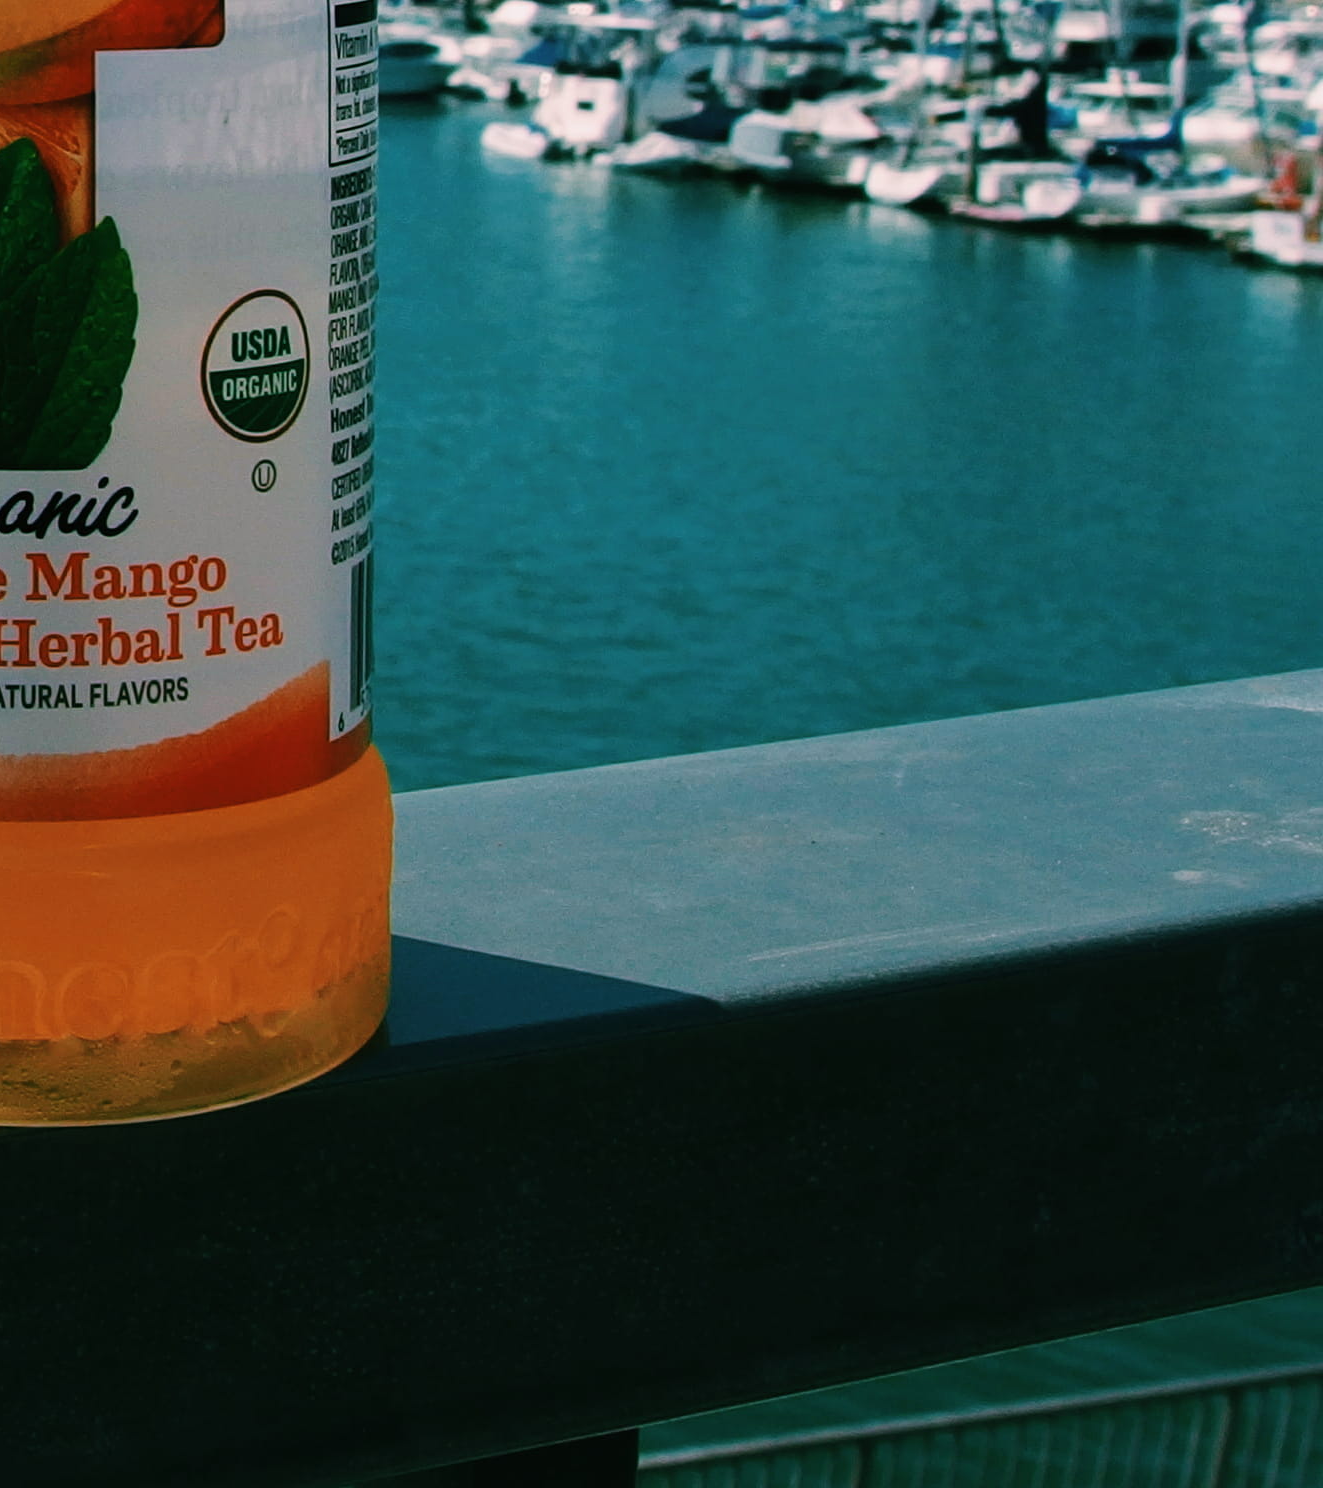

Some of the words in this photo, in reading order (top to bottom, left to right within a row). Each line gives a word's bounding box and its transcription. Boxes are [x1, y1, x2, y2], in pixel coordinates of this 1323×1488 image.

[231, 325, 292, 363] USDA
[222, 368, 298, 402] ORGANIC
[25, 552, 227, 608] Mango
[197, 606, 284, 657] Tea
[90, 677, 190, 708] FLAVORS
